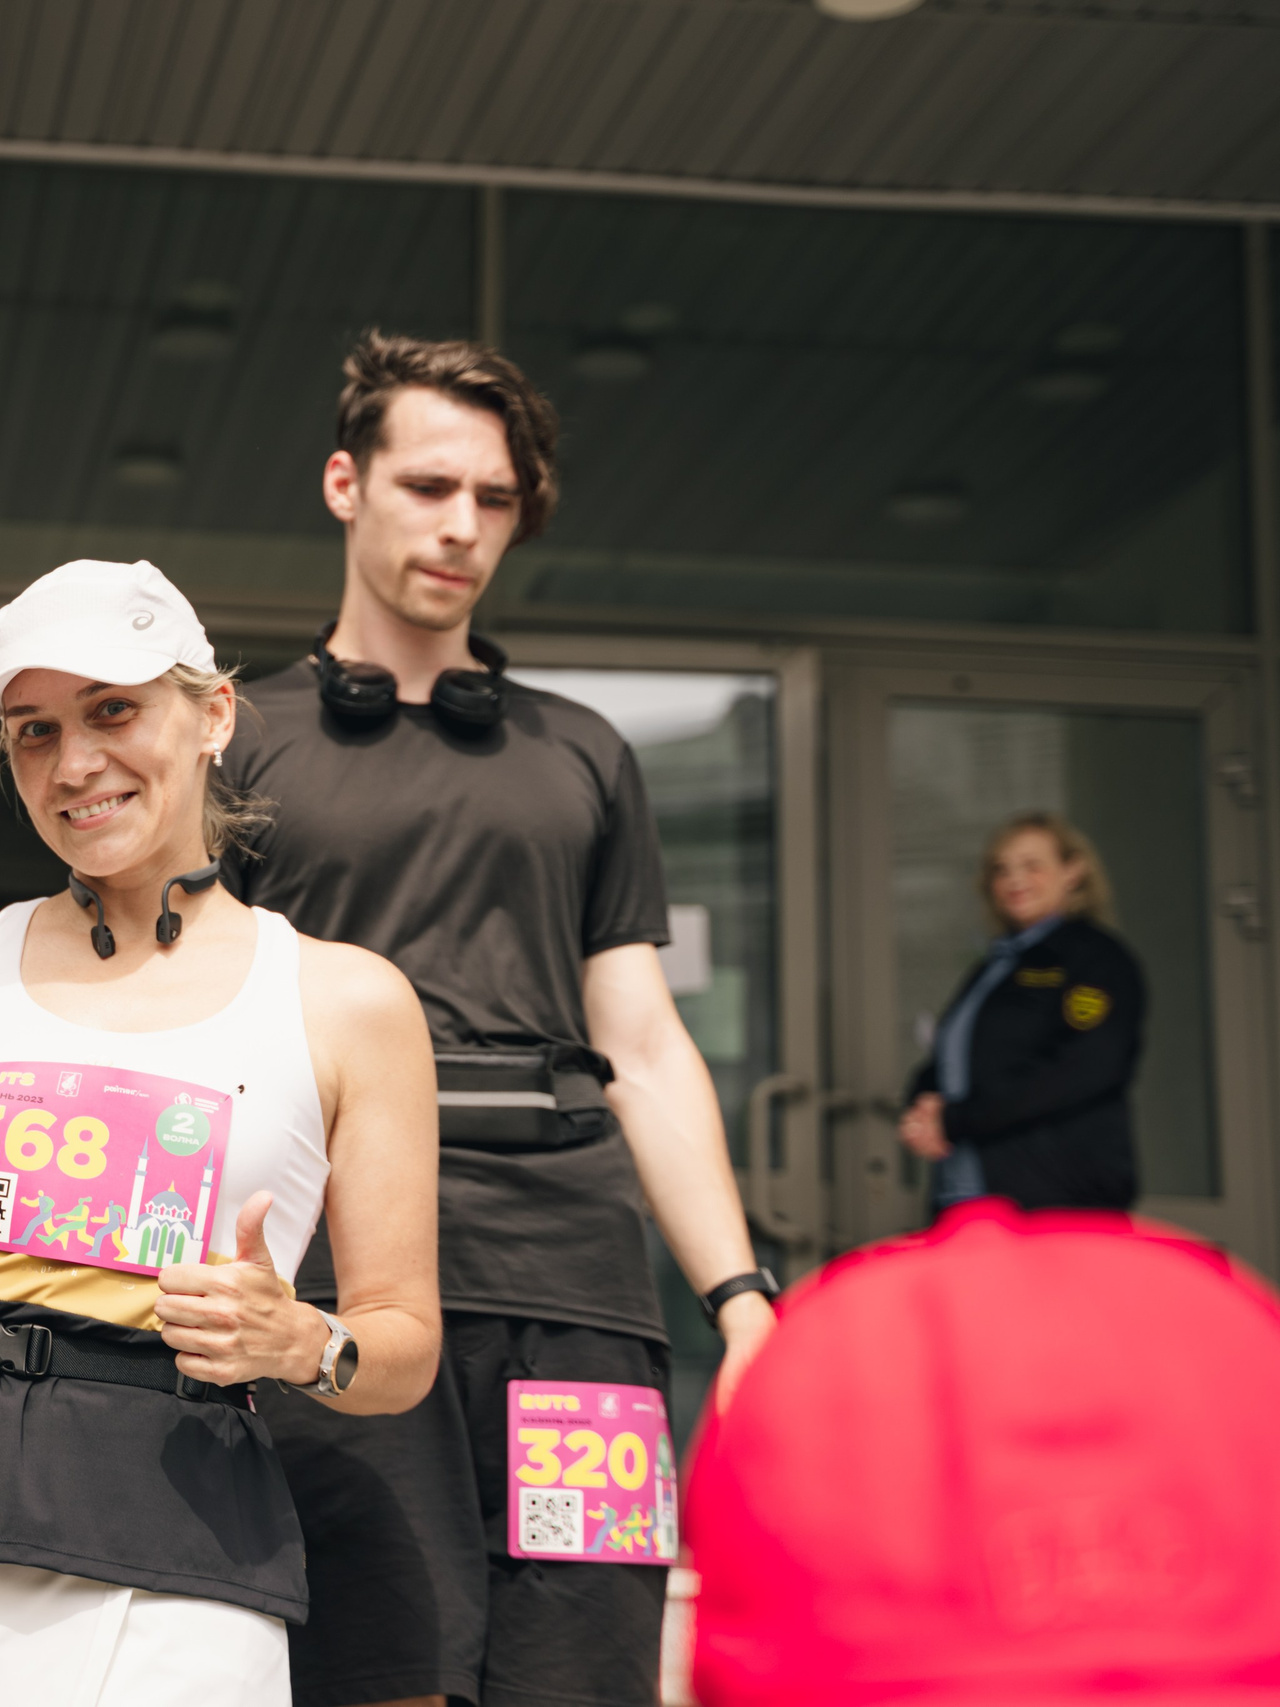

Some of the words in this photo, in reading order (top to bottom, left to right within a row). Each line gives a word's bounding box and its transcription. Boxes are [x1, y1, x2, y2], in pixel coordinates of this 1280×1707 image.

[16, 1093, 44, 1105] 2023
[171, 1111, 196, 1135] 2
[162, 1132, 200, 1147] ВОЛНА
[514, 1427, 649, 1492] 320
